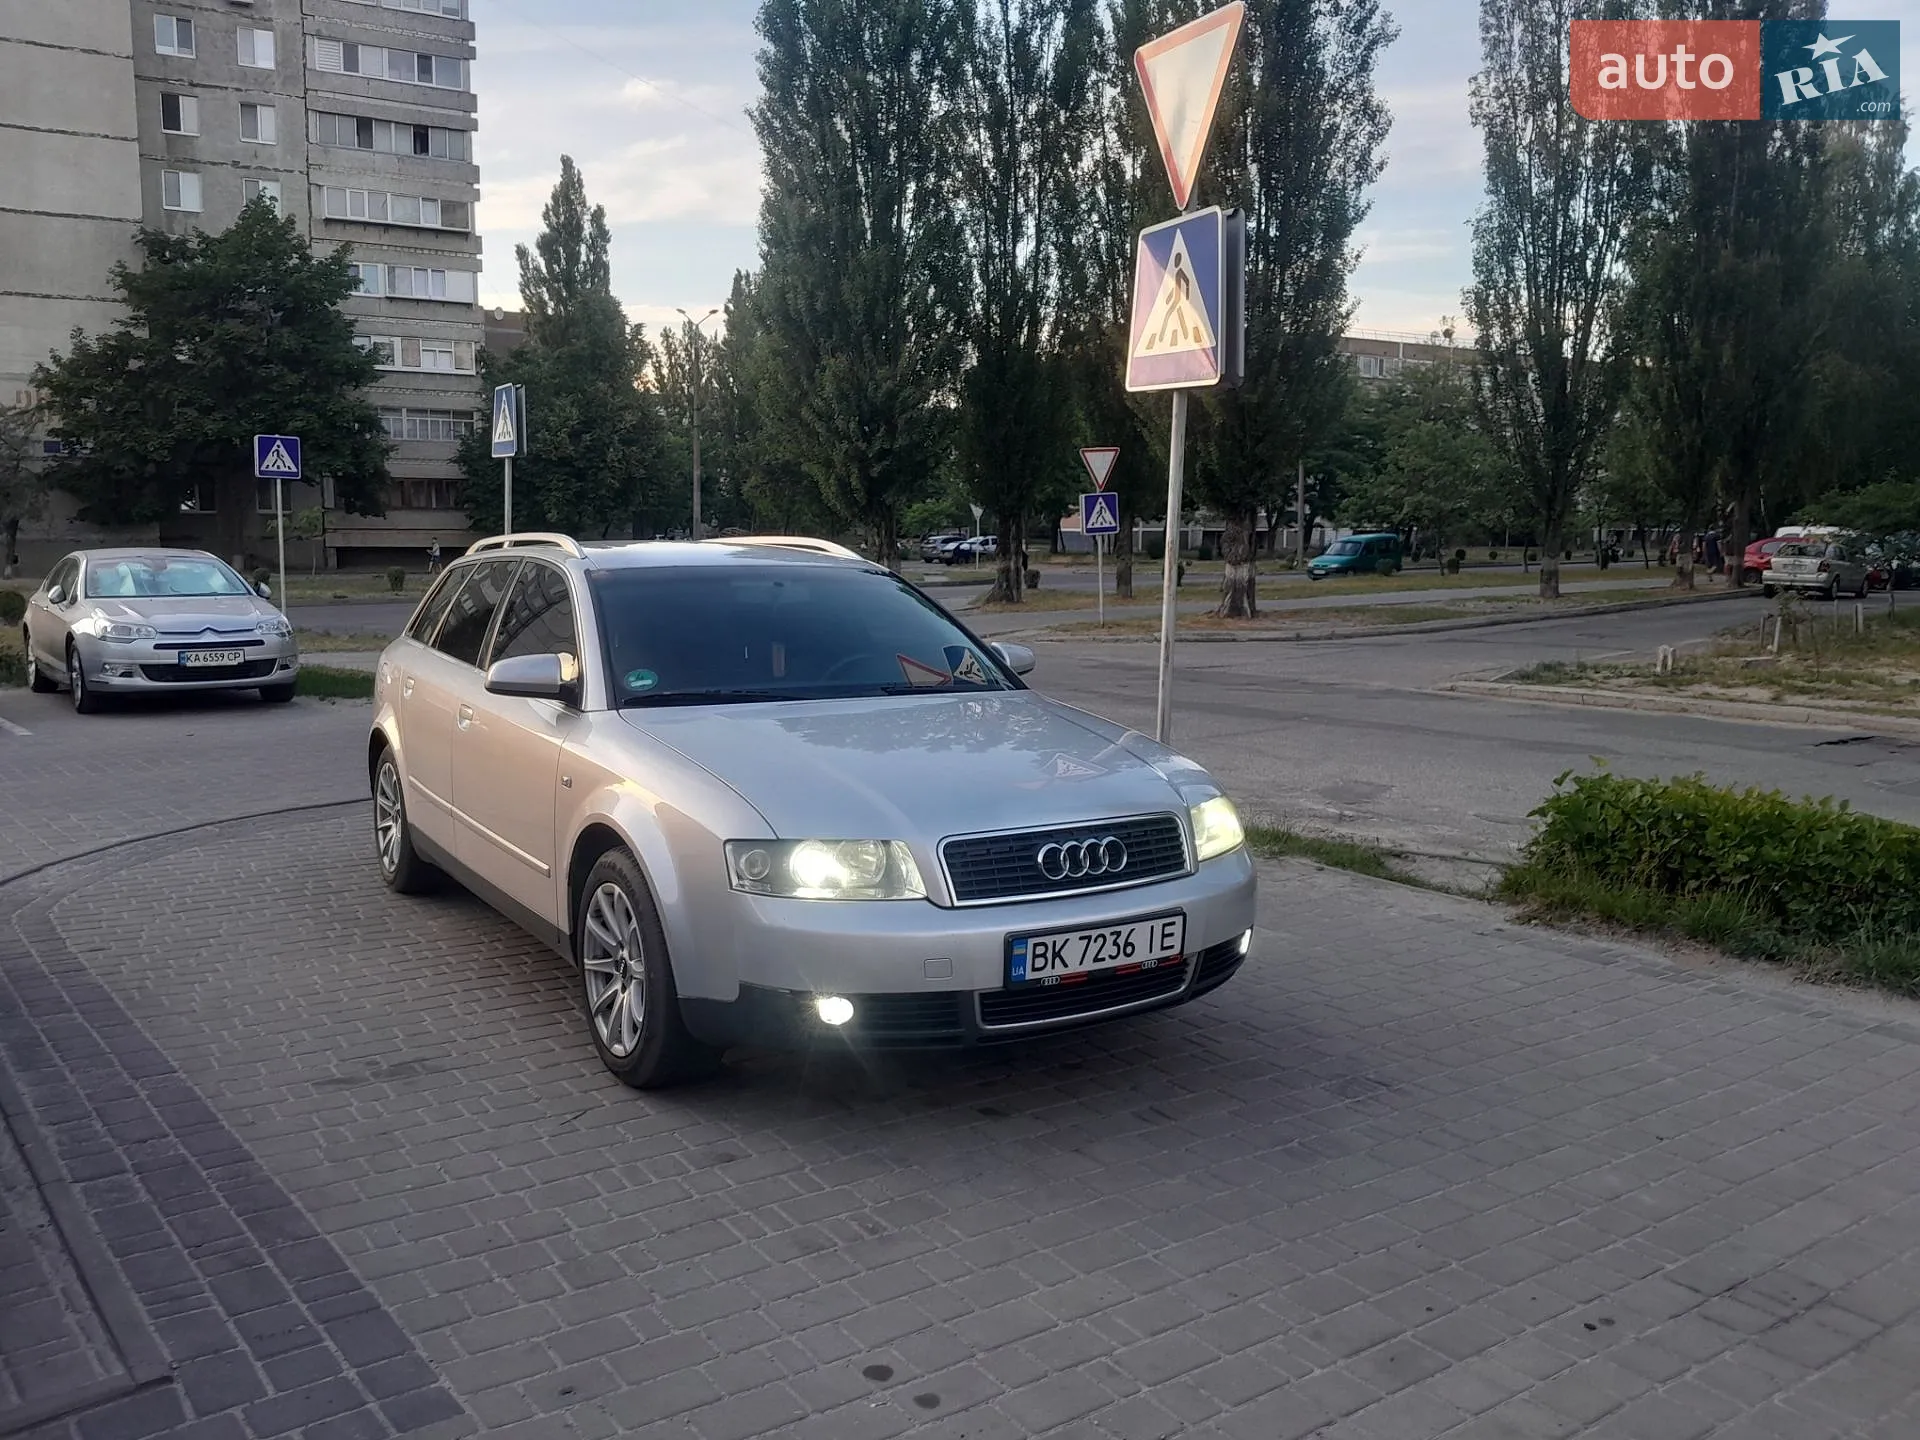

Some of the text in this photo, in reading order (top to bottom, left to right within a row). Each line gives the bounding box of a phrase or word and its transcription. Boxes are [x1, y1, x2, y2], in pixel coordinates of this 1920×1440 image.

[186, 652, 241, 663] KA 6559 CP
[1031, 921, 1177, 973] BK 7236 IE
[1012, 965, 1025, 977] UA
